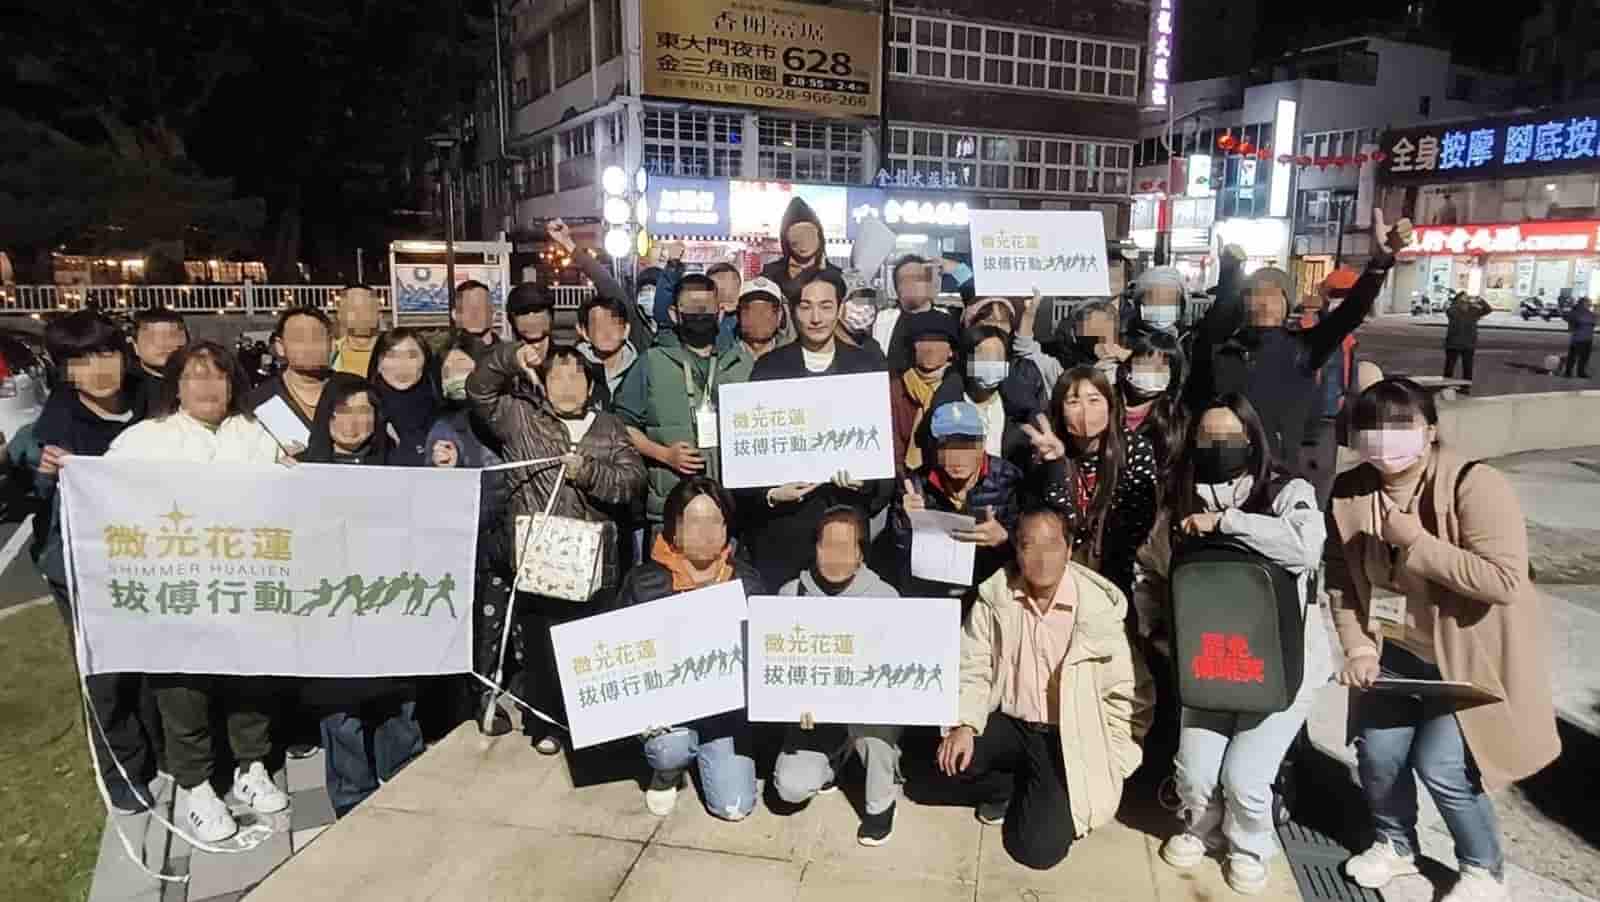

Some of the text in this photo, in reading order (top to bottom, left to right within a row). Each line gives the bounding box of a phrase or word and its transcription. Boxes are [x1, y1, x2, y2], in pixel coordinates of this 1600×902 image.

[656, 31, 777, 61] 東大門夜市
[656, 53, 777, 83] 金三角商圈
[782, 46, 853, 77] 628
[754, 85, 868, 107] 0928-966-266
[1391, 116, 1600, 172] 全身按摩 腳底按
[733, 434, 809, 457] 拔傅行動
[104, 524, 293, 562] 微光花蓮
[107, 563, 291, 578] SHIMMER HUALIEN
[108, 577, 294, 616] 拔傅行動
[578, 670, 664, 709] 拔傅行動
[763, 664, 855, 687] 拔傅行動
